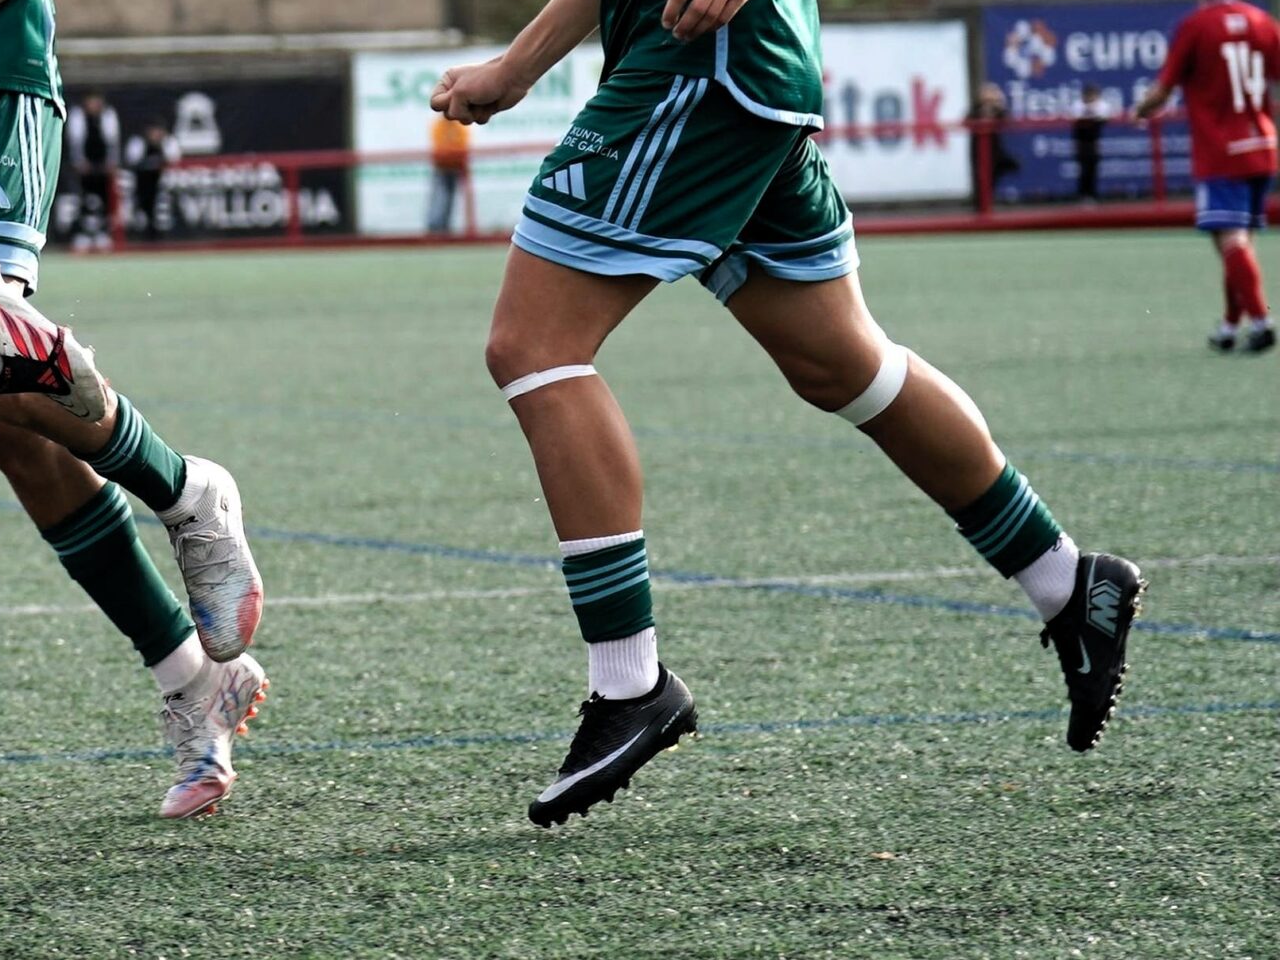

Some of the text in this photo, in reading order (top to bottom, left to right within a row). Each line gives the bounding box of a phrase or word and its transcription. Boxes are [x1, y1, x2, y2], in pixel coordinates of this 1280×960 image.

[1065, 29, 1168, 73] euro
[1221, 41, 1266, 114] 14
[563, 136, 578, 147] DE
[569, 125, 605, 144] XUNTA
